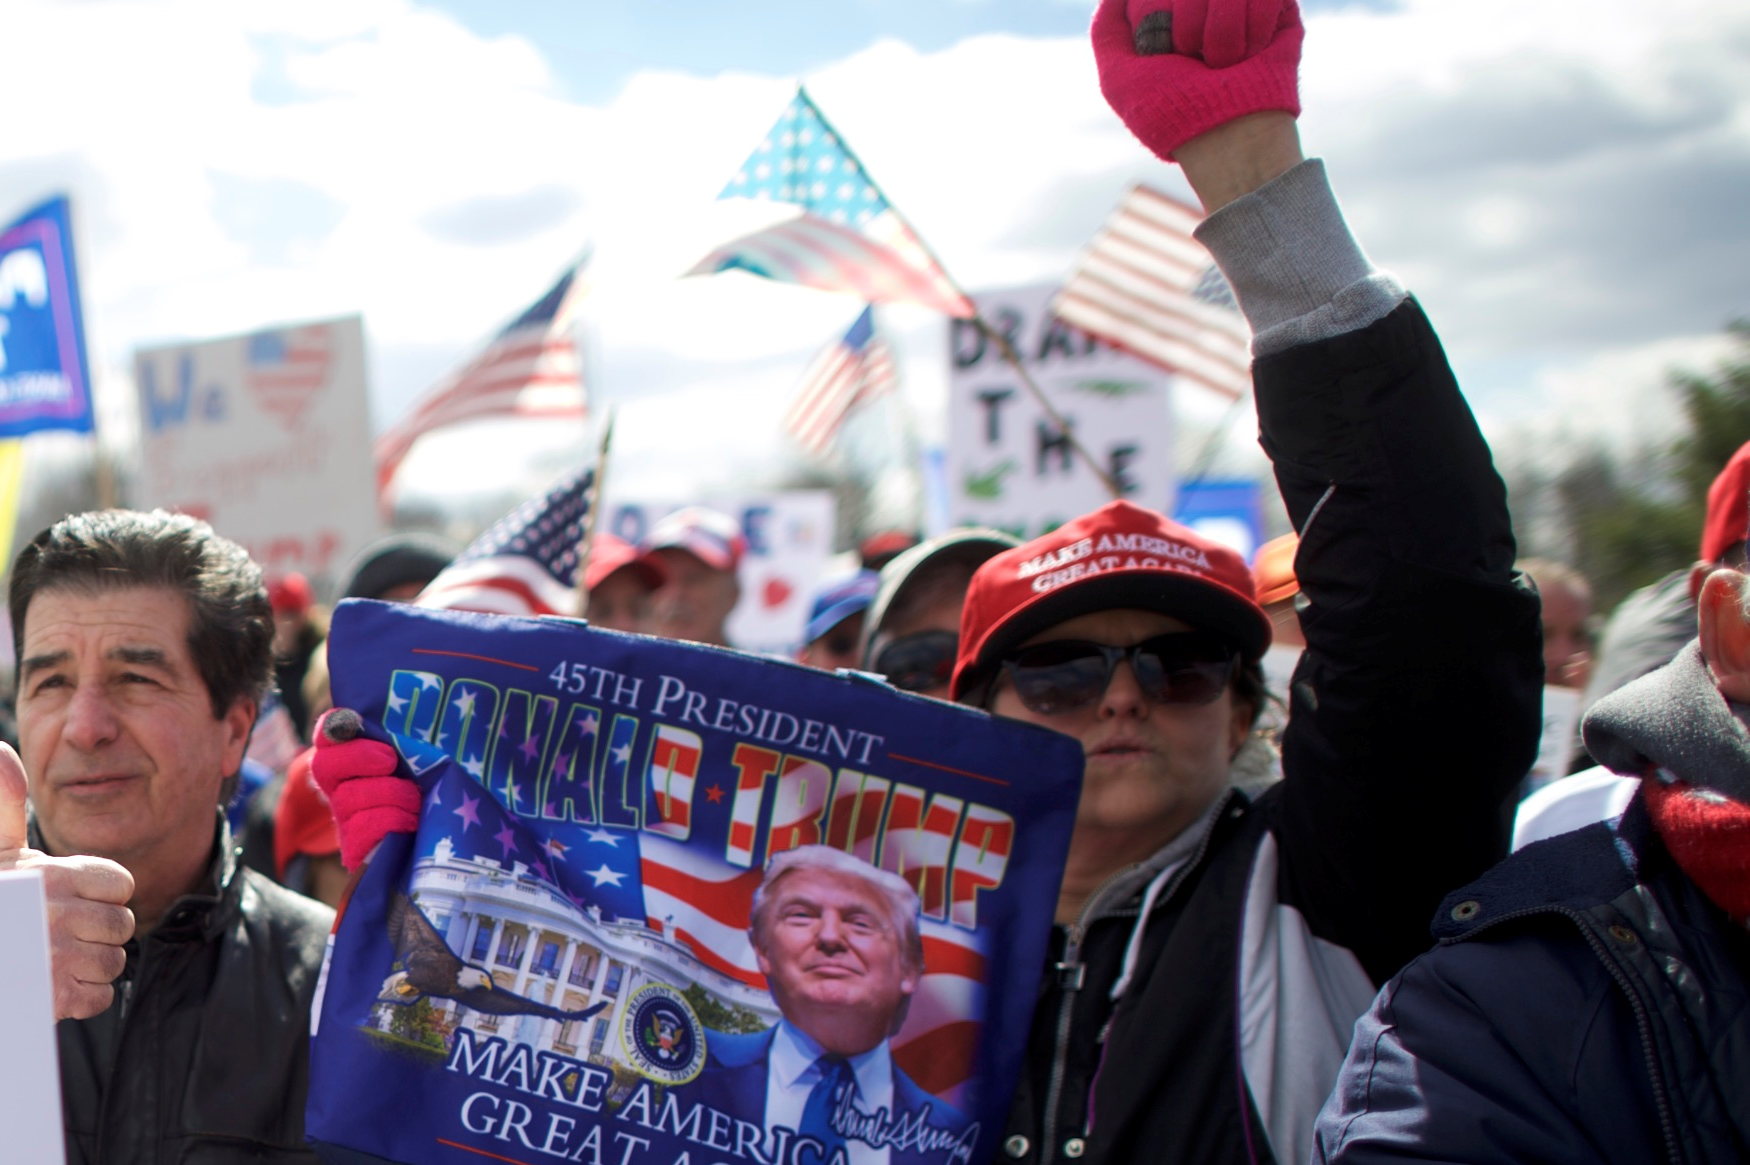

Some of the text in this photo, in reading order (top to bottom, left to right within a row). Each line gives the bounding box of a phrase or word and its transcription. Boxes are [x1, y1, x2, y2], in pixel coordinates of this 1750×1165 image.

[977, 389, 1139, 494] THE
[1018, 533, 1212, 580] MAKE AMERICA
[1031, 557, 1119, 594] GREAT
[549, 660, 884, 765] 45TH PRESIDENT
[383, 669, 1014, 930] DONALD TRUMP
[626, 986, 670, 1017] PRESIDENT
[630, 1049, 651, 1073] SEAL
[690, 1015, 703, 1060] UNITED
[447, 1032, 609, 1112] MAKE
